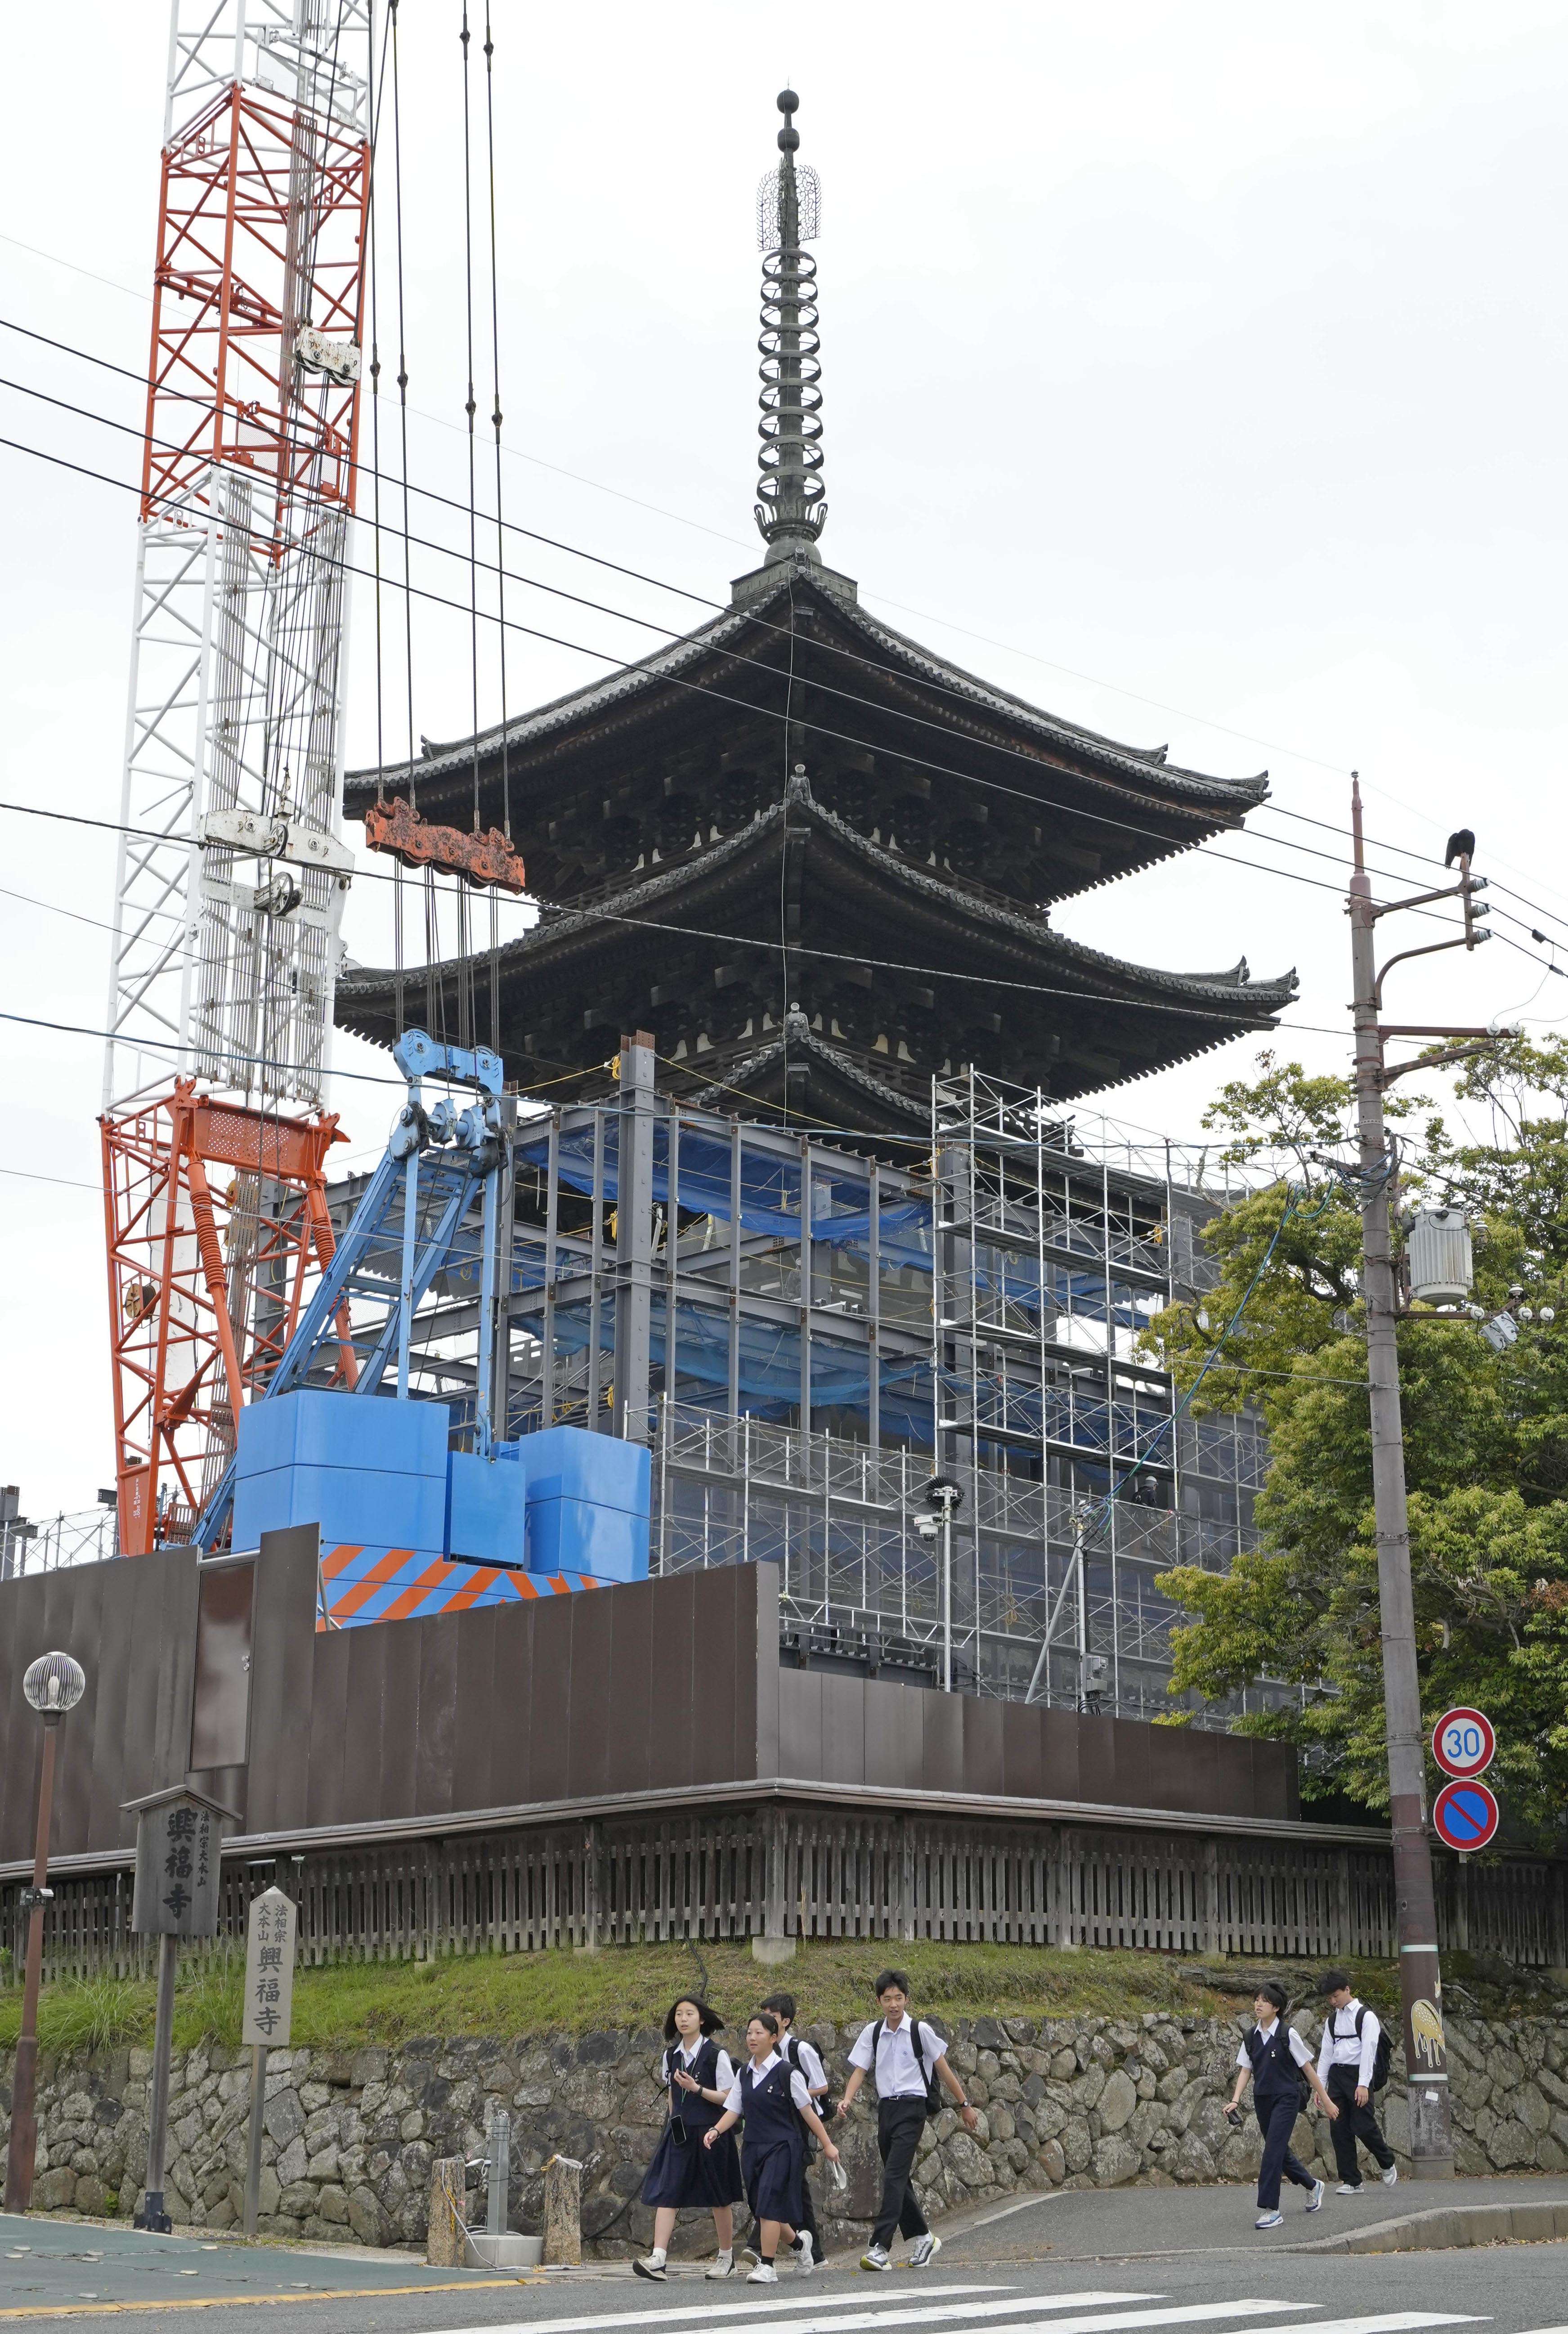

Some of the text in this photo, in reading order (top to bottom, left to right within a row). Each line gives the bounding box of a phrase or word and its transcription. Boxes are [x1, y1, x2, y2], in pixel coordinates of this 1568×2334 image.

[1447, 1728, 1480, 1758] 30
[162, 1807, 198, 1920] 興福寺
[197, 1810, 210, 1887] 法相宗大本山
[257, 1902, 271, 1942] 大本山
[274, 1904, 288, 1943] 法相宗
[253, 1945, 283, 2036] 興福寺
